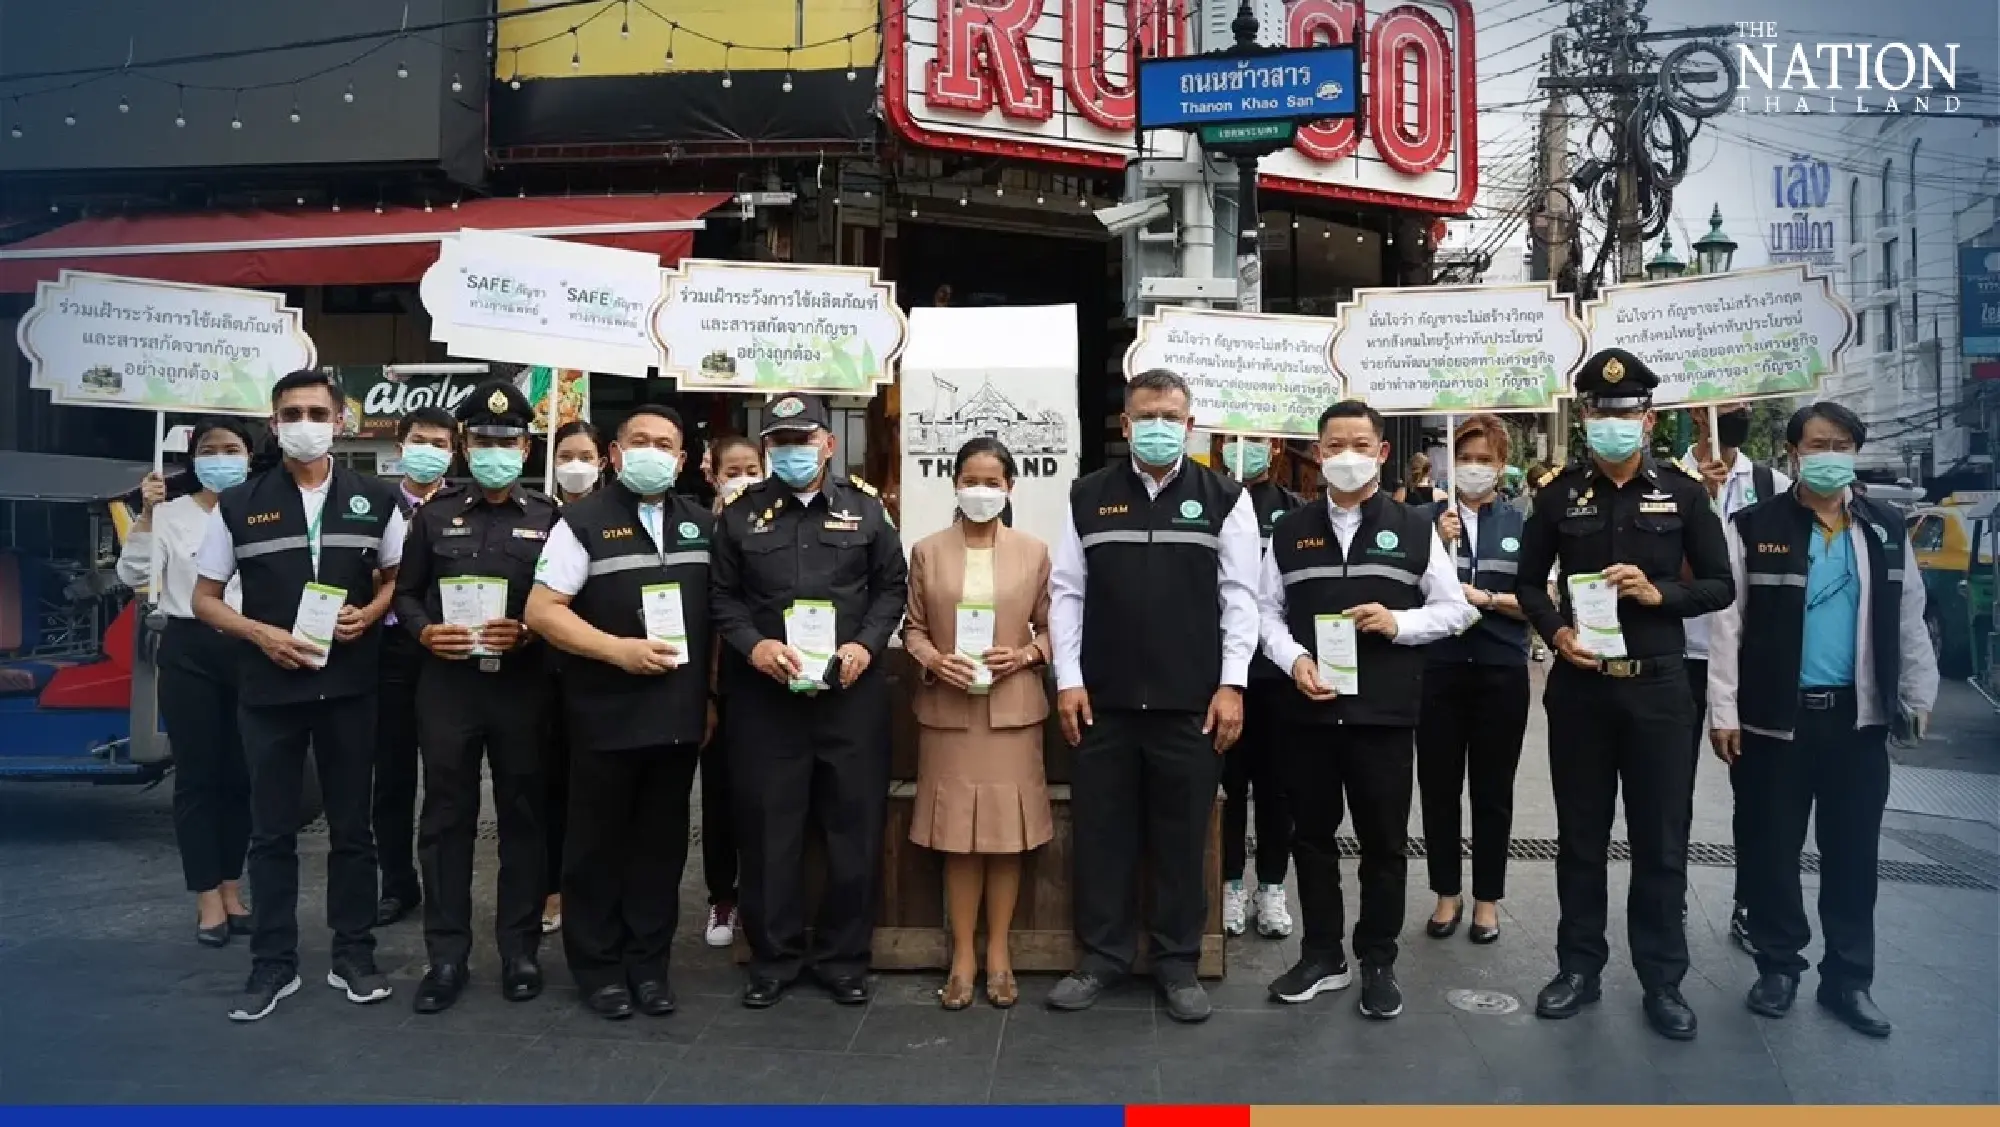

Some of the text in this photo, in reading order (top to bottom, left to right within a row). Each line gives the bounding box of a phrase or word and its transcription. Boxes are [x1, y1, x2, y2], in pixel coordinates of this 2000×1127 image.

[1180, 60, 1311, 94] ถนนข้าวสาร
[1180, 96, 1314, 114] Thanon Khao San
[467, 274, 511, 294] SAFE
[567, 286, 611, 306] SAFE
[701, 318, 857, 340] และสารสกัดจากกัญชา
[82, 331, 260, 361] และสารสกัดจากกัญชา
[737, 344, 821, 366] อย่างถูกต้อง
[124, 360, 219, 384] อย่างถูกต้อง
[918, 457, 1058, 478] THND
[247, 511, 281, 526] DTAM
[1099, 504, 1129, 516] DTAM
[602, 527, 634, 539] DTAM
[1296, 537, 1324, 549] DTAM
